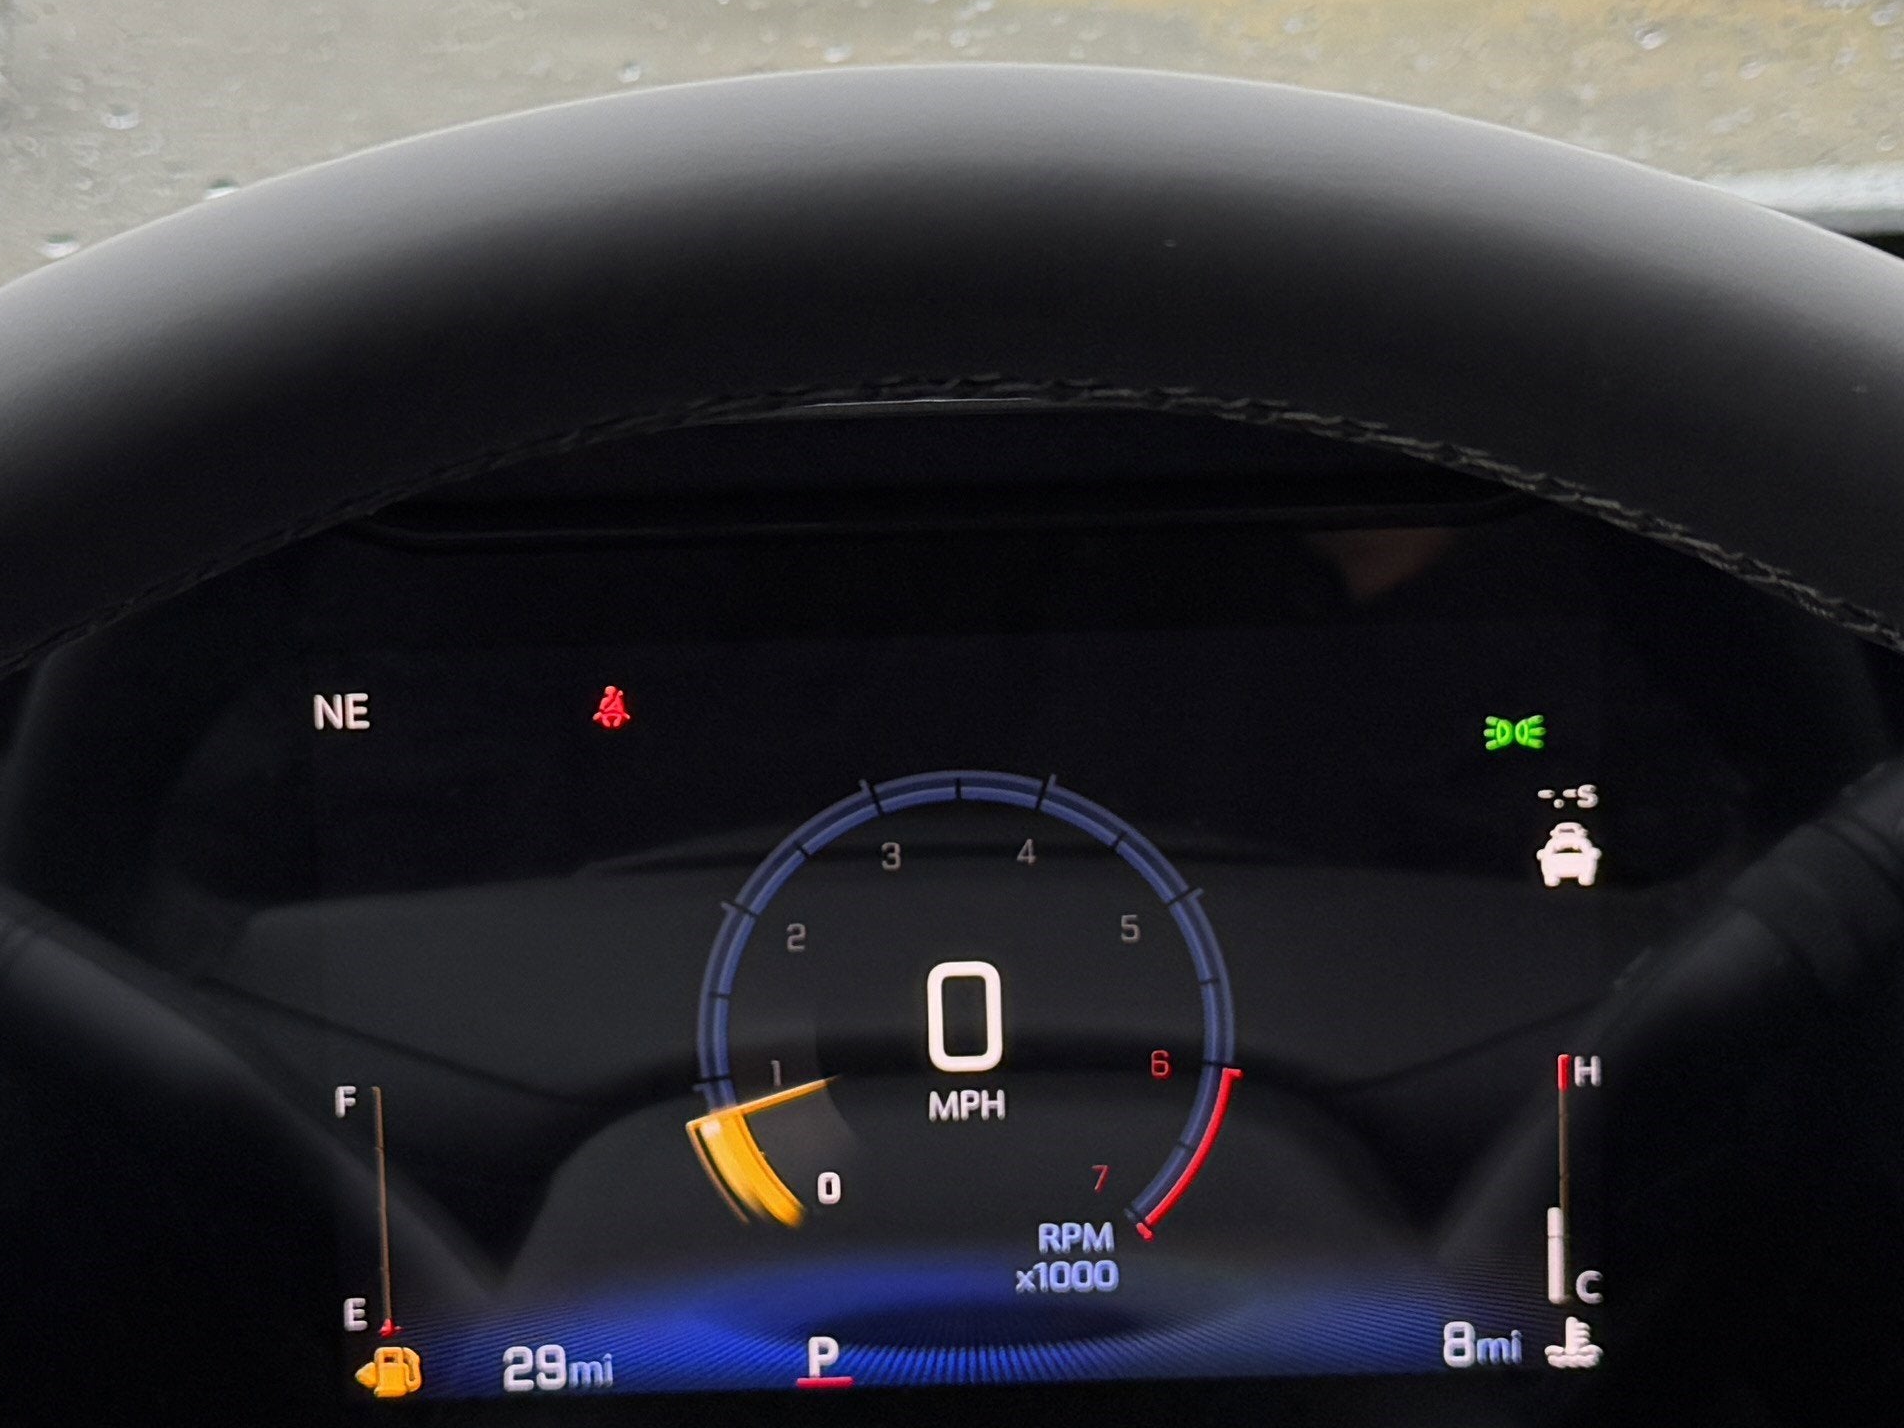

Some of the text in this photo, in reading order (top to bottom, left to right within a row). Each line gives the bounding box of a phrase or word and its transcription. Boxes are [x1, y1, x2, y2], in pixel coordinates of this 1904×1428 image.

[314, 692, 370, 730] NE
[881, 842, 902, 870] 3
[1015, 838, 1036, 865] 4
[786, 923, 807, 951] 2
[1120, 914, 1141, 942] 5
[926, 960, 1003, 1073] 0
[770, 1059, 783, 1087] 1
[1150, 1049, 1171, 1078] 6
[1575, 1055, 1600, 1086] H
[335, 1084, 357, 1117] F
[927, 1088, 1007, 1121] MPH
[817, 1171, 841, 1205] 0
[1092, 1164, 1110, 1191] 7
[1037, 1222, 1116, 1253] RPM
[1015, 1259, 1120, 1293] x1000
[1576, 1269, 1601, 1304] C
[343, 1296, 367, 1332] E
[808, 1336, 839, 1374] P
